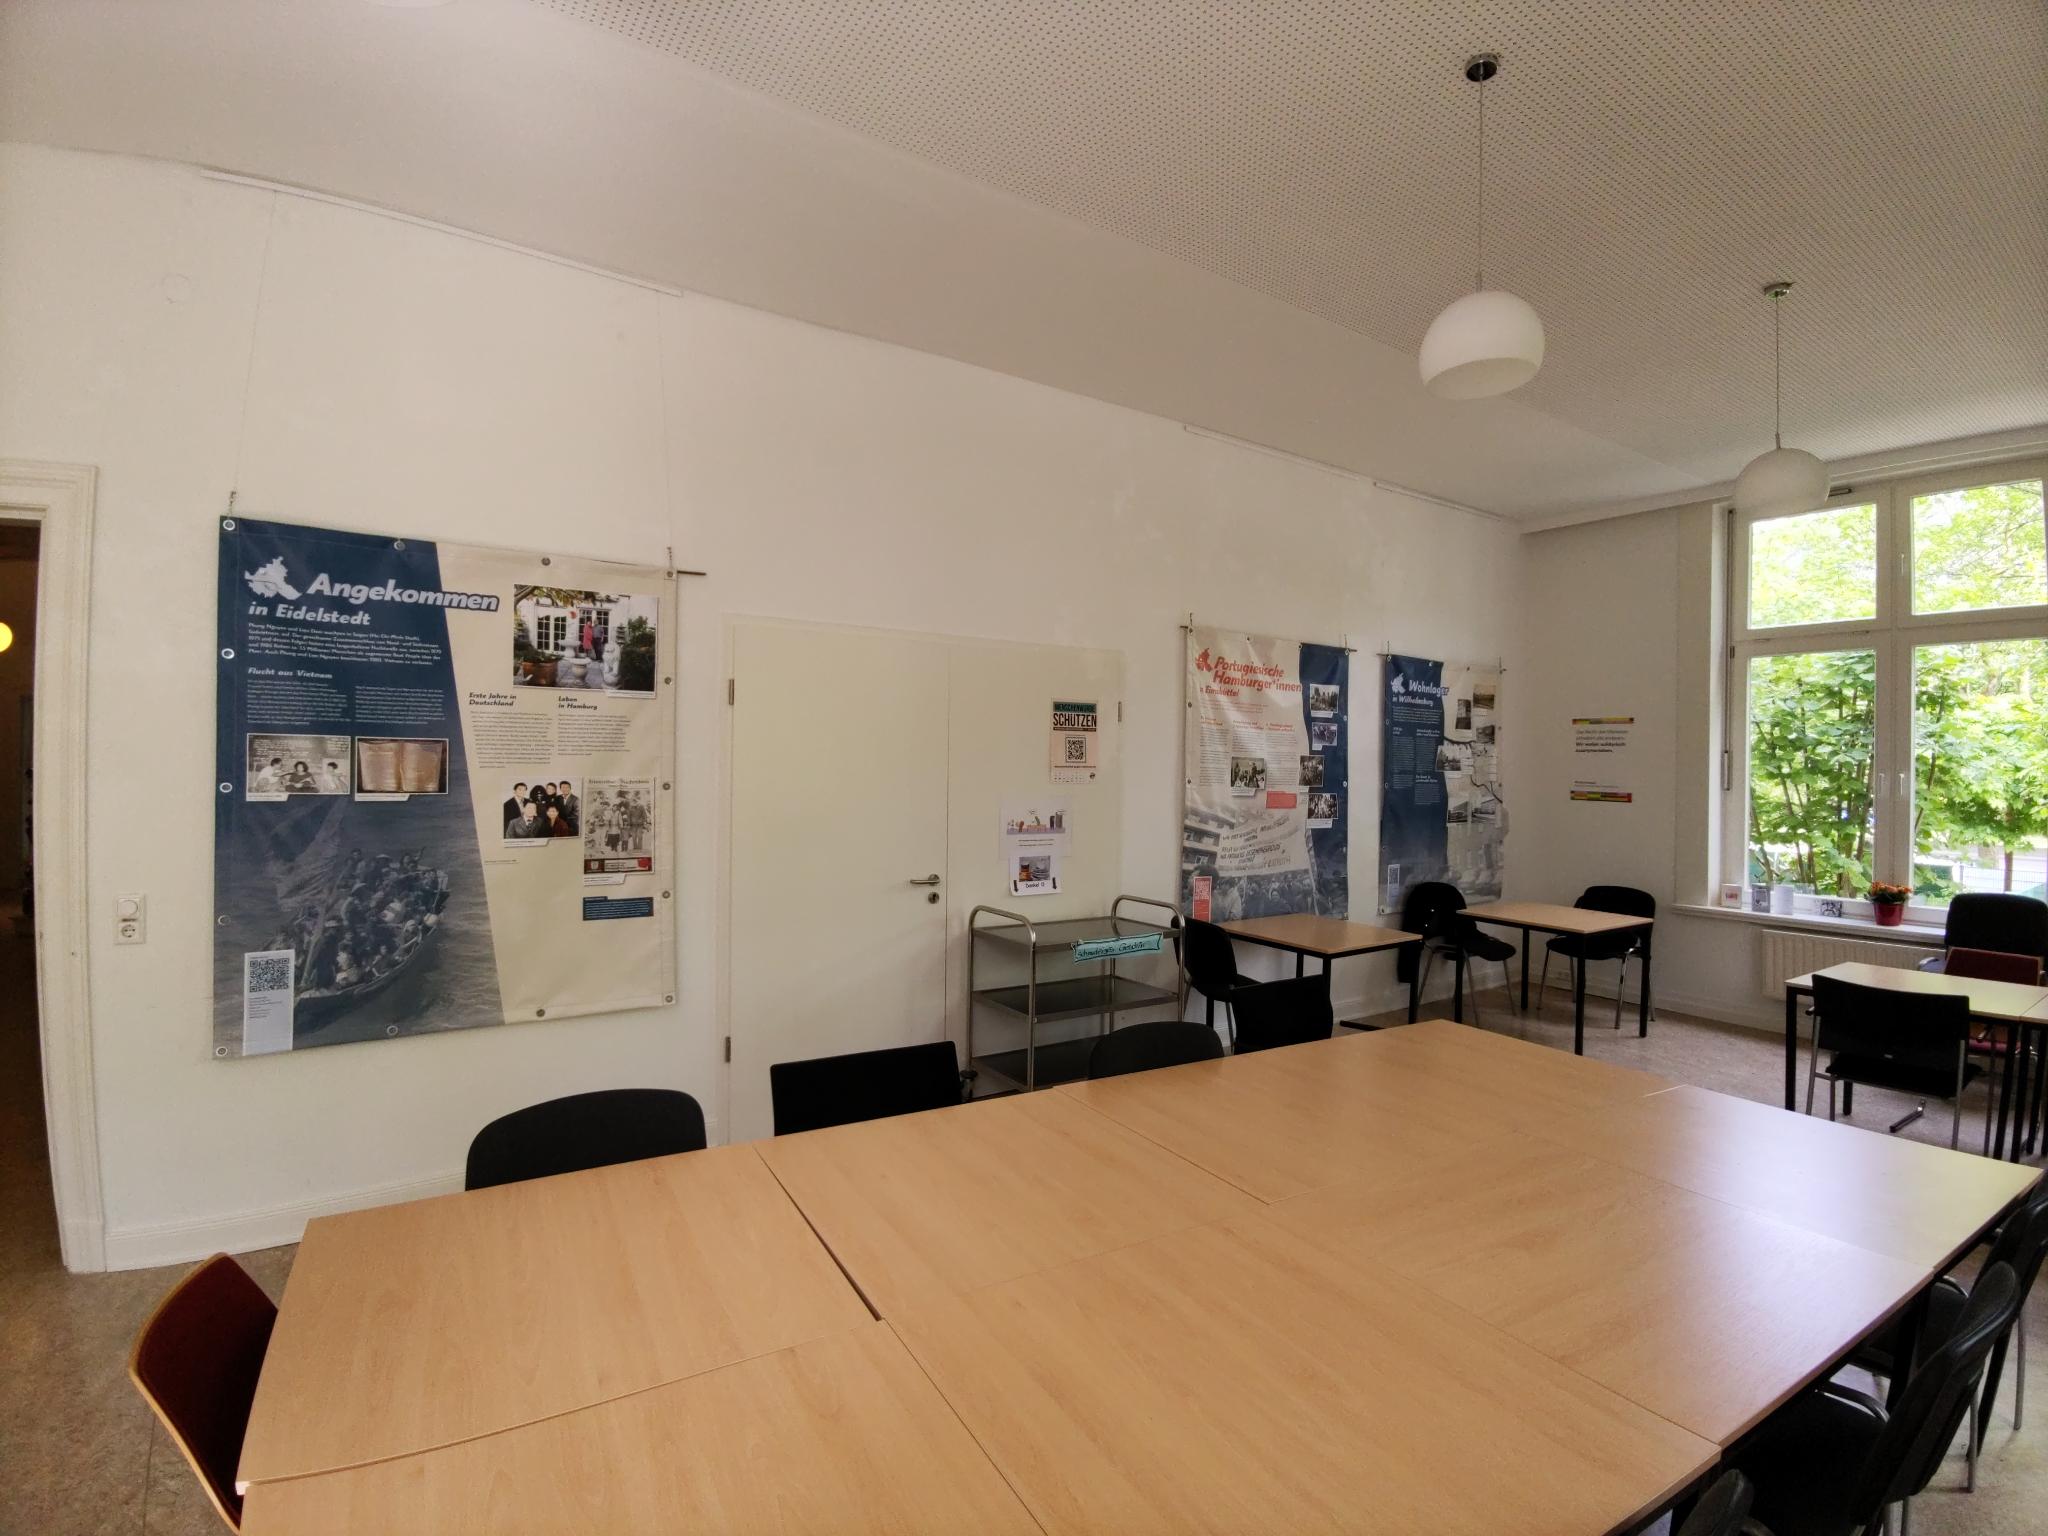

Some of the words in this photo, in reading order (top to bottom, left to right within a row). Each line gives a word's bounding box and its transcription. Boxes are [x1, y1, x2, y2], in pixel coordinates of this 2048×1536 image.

[306, 572, 499, 611] Angekommen
[248, 601, 269, 615] in
[275, 603, 371, 626] Eidelstedt
[248, 666, 275, 675] Flucht
[297, 669, 333, 679] Vietnam
[1213, 655, 1284, 678] Portugiesische
[488, 692, 508, 700] Jahre
[1409, 679, 1449, 698] Wohnlager
[469, 699, 514, 707] Deutschland
[566, 703, 598, 711] Hamburg
